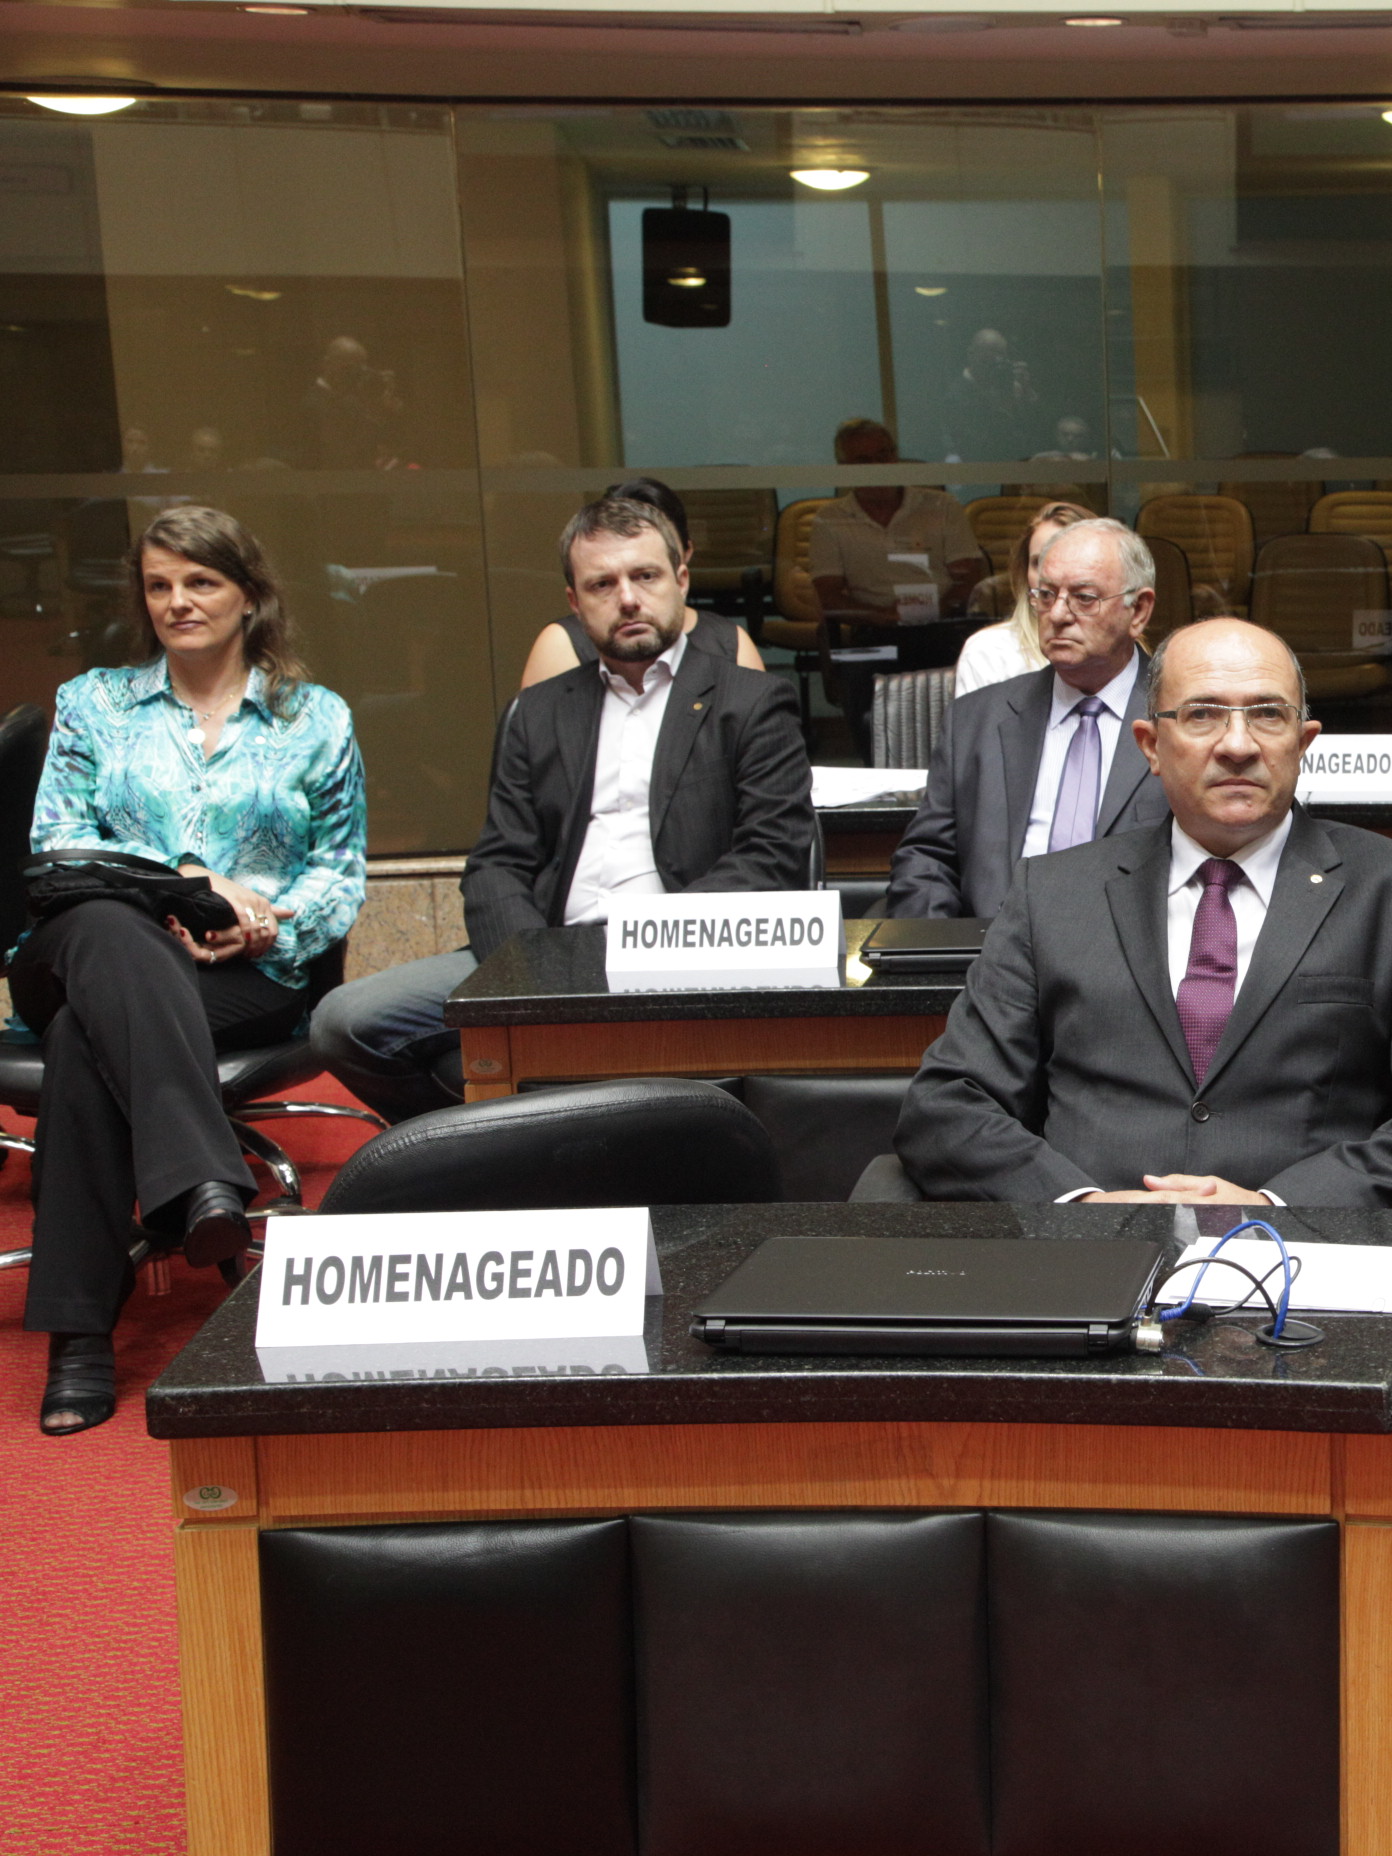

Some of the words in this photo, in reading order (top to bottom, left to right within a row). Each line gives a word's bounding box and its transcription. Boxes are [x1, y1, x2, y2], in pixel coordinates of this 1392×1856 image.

[1302, 753, 1392, 774] NAGEADO
[621, 916, 824, 949] HOMENAGEADO
[282, 1246, 626, 1306] HOMENAGEADO
